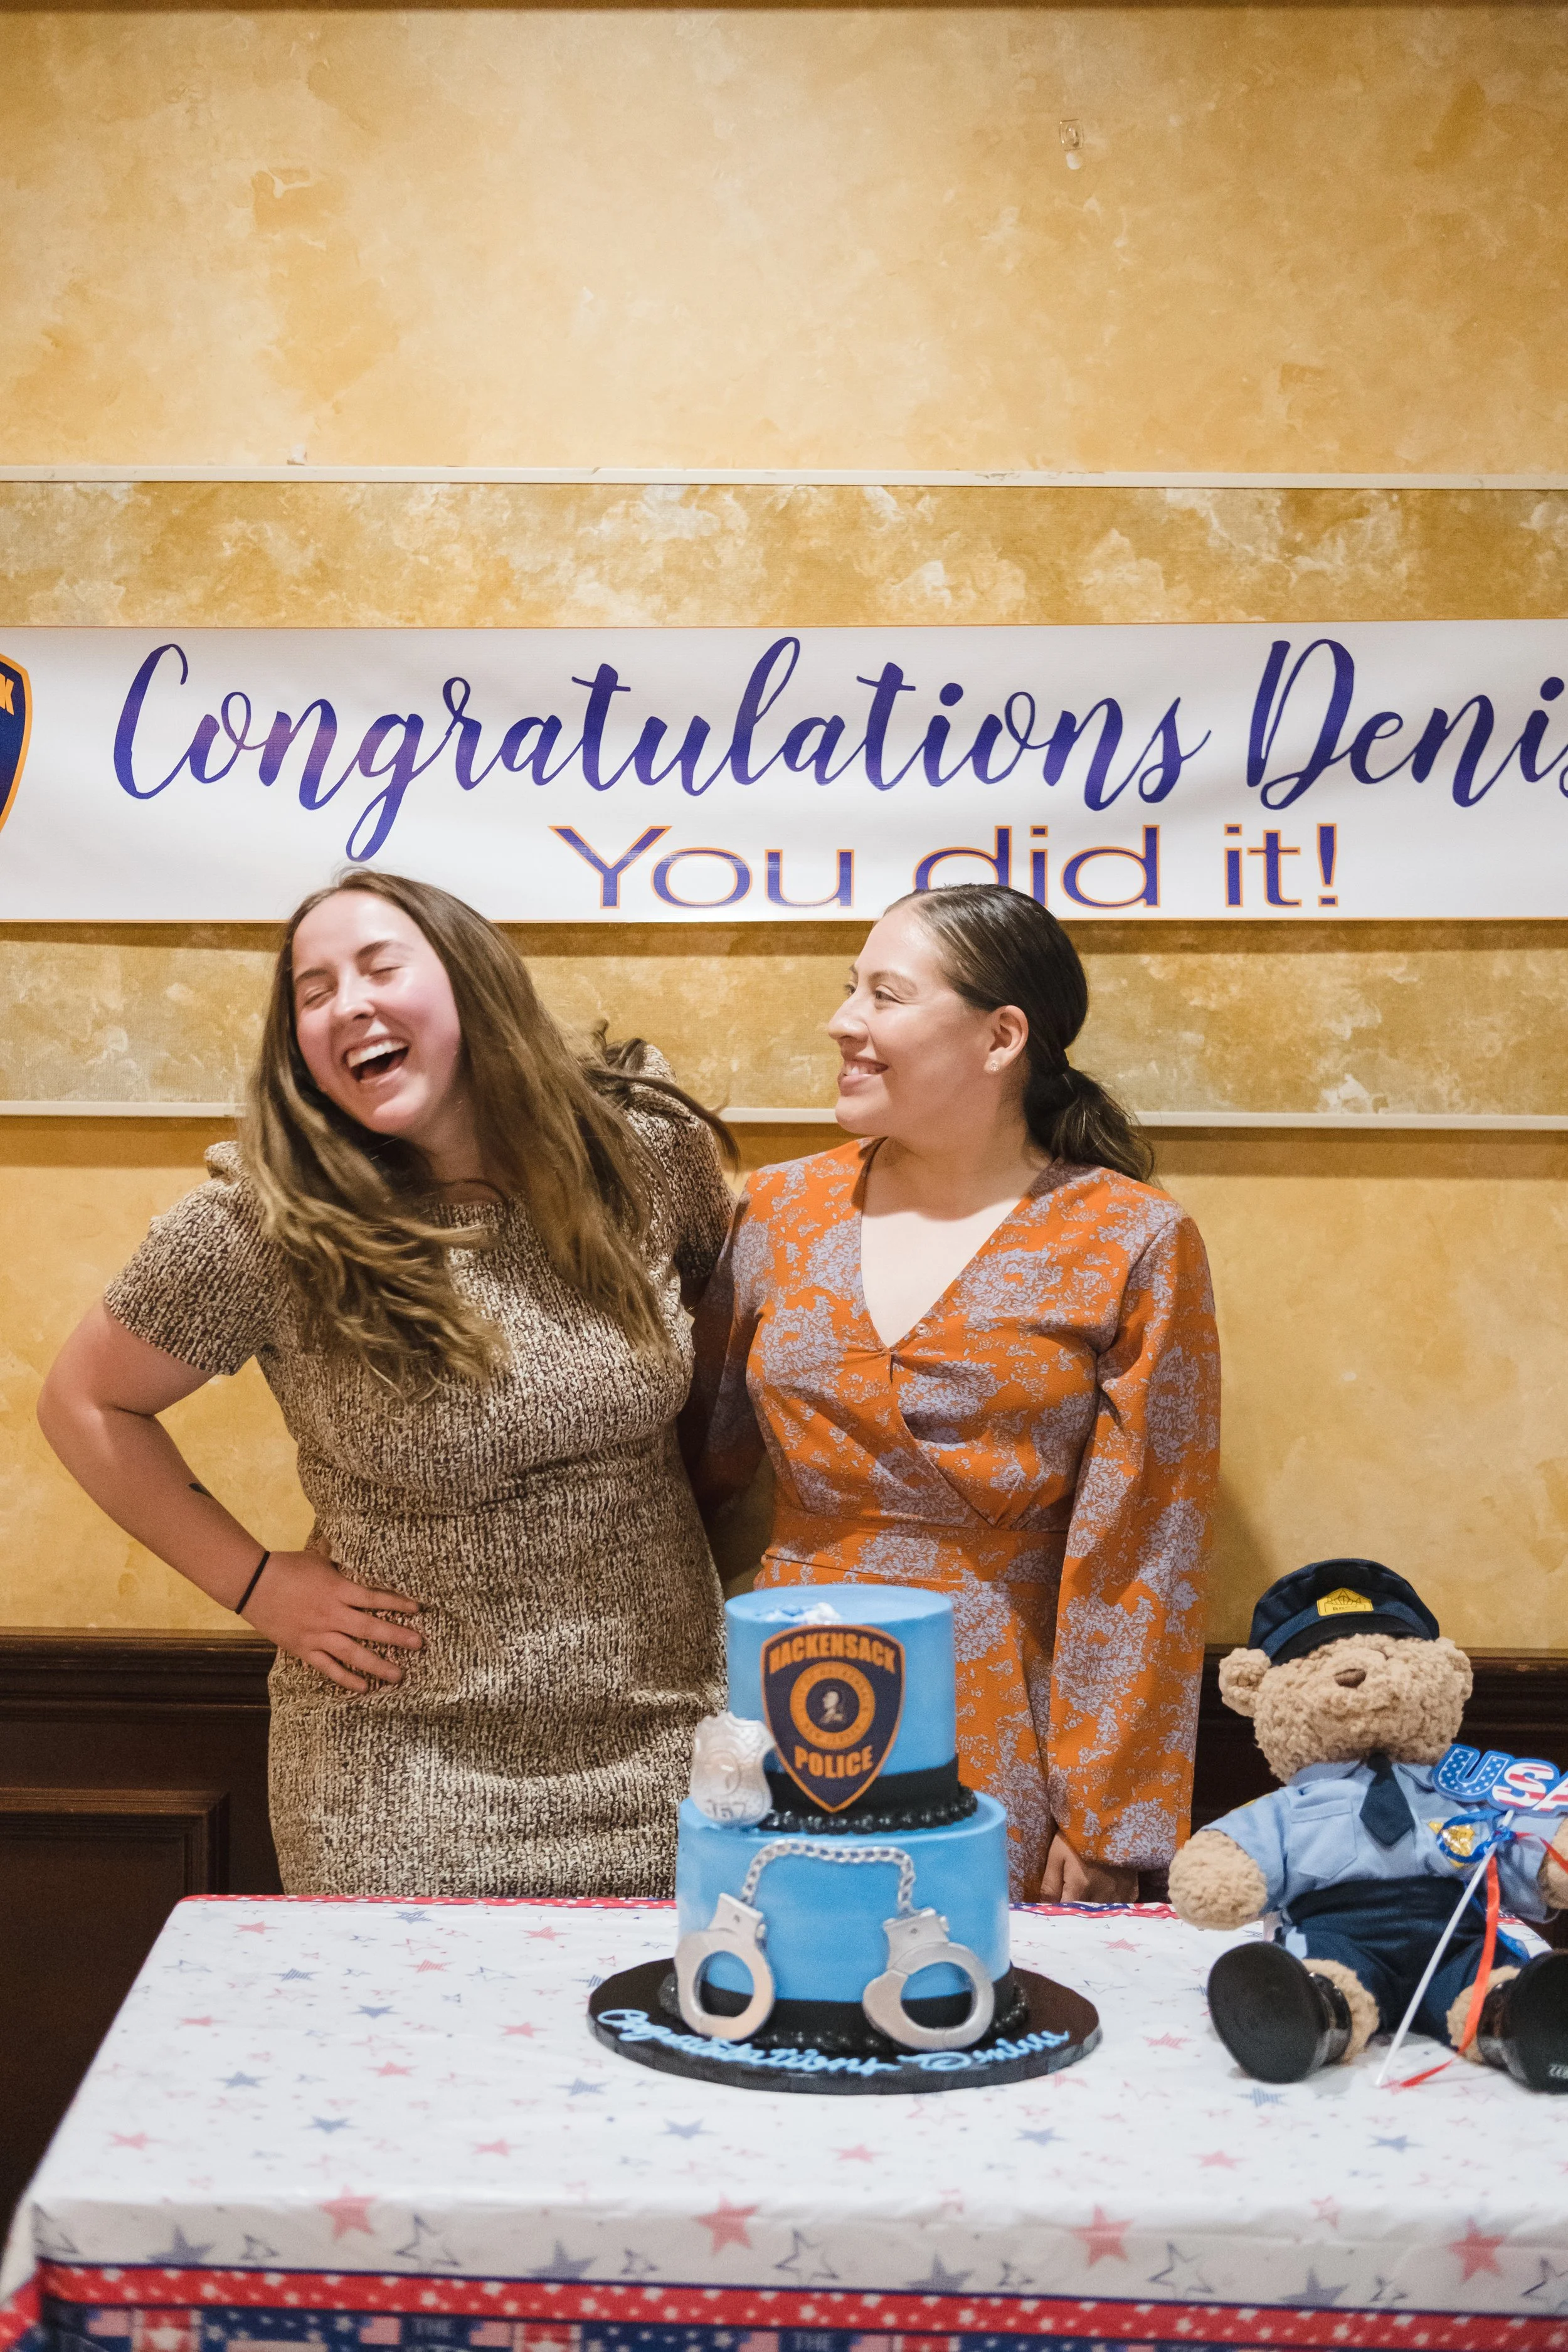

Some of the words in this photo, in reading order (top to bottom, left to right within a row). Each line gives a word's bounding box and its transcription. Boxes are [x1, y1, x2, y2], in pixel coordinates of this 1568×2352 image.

[114, 636, 1211, 862] Congratulations
[1246, 638, 1568, 811] Deni
[547, 825, 855, 909] You
[912, 824, 1160, 909] did
[1224, 823, 1338, 908] it!
[769, 1633, 896, 1674] HACKENSACK
[794, 1745, 873, 1779] POLICE
